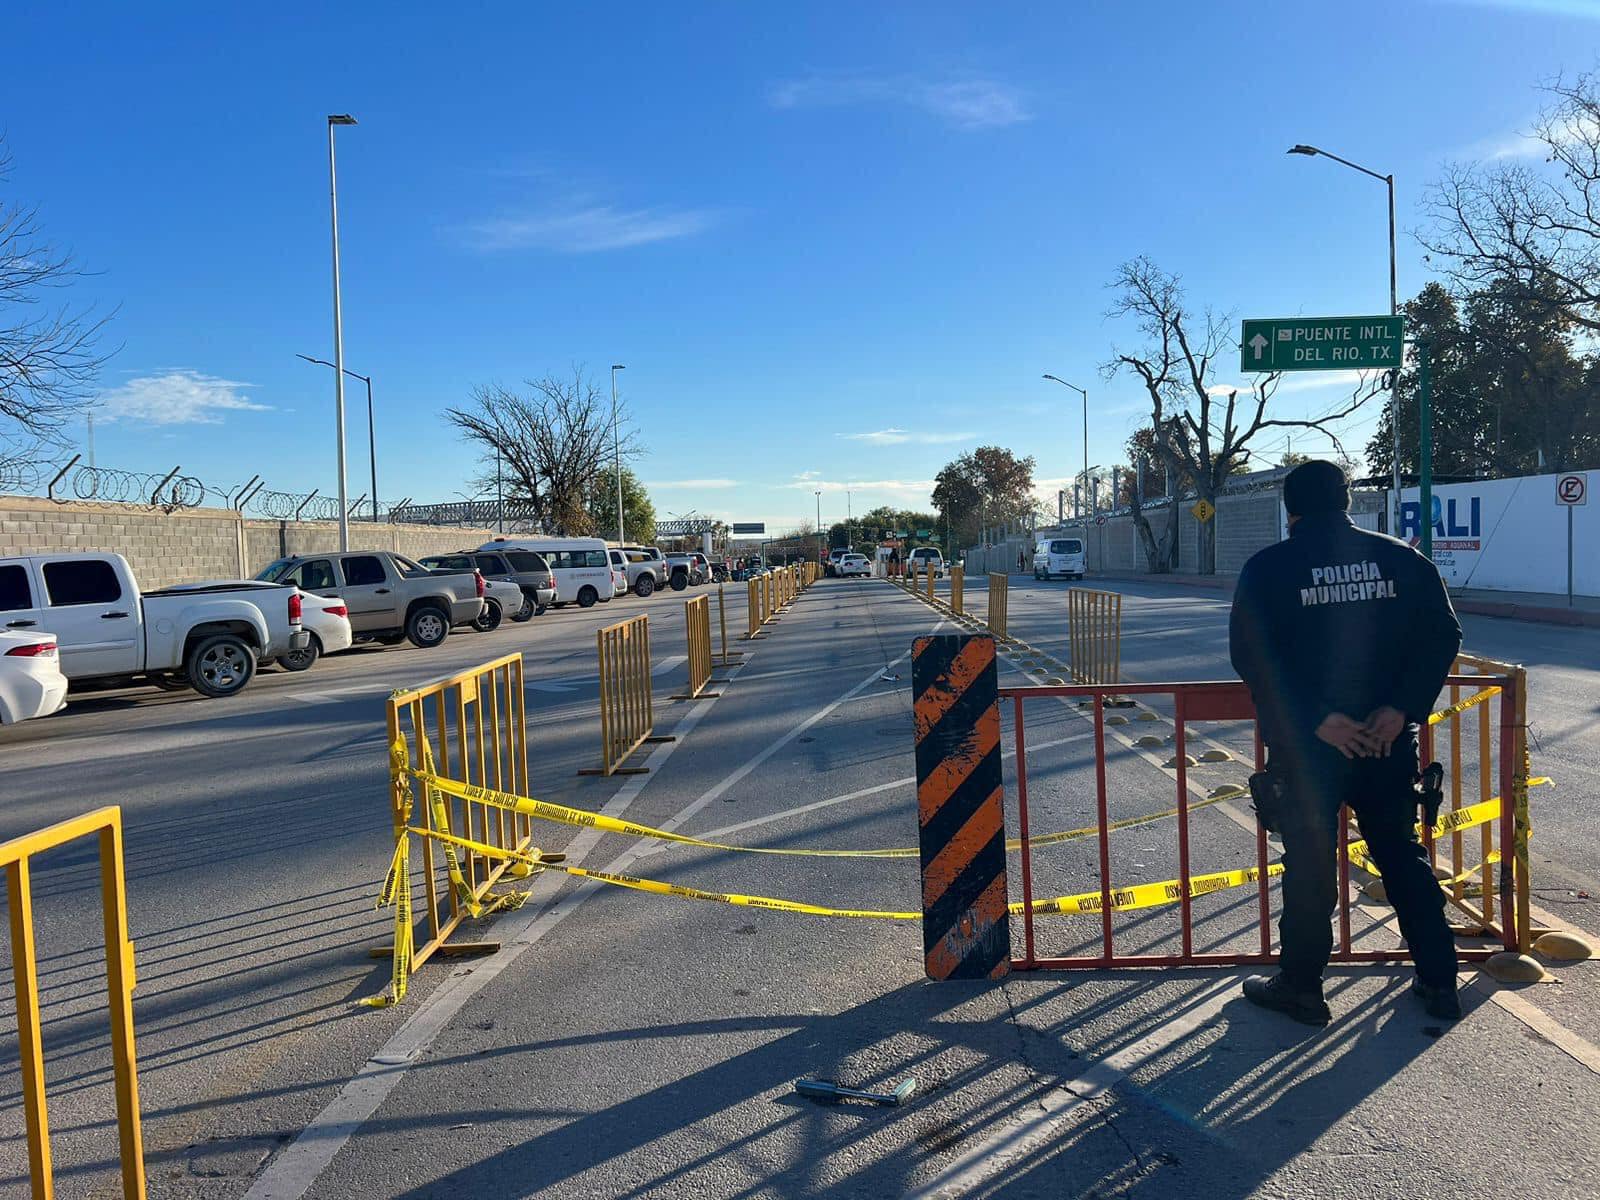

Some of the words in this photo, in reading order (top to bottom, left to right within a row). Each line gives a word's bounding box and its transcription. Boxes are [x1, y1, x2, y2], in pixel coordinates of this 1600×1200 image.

[1295, 327, 1352, 341] PUENTE
[1359, 325, 1396, 340] INTL.
[1294, 347, 1325, 361] DEL
[1311, 560, 1382, 585] POLICÍA
[1300, 580, 1397, 606] MUNICIPAL
